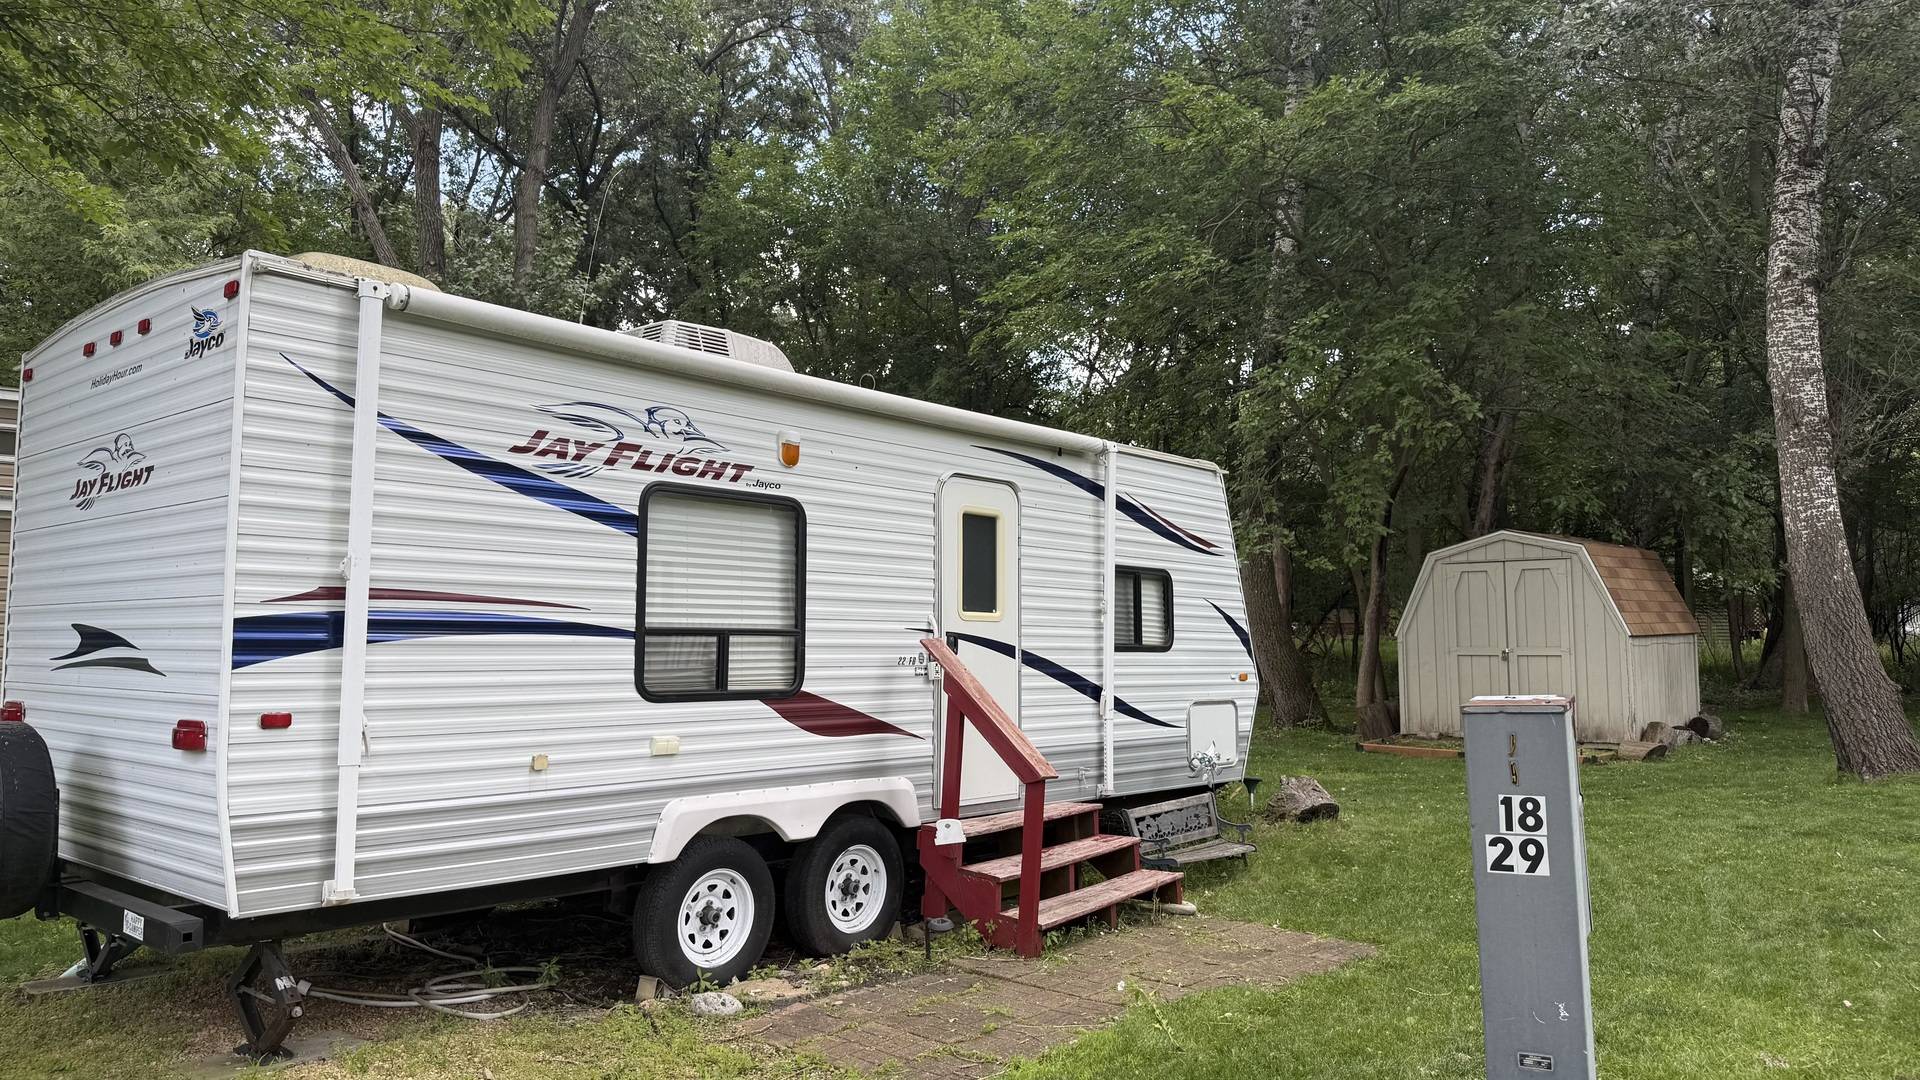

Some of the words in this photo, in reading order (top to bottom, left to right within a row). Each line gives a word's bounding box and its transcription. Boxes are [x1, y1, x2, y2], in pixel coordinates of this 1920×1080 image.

[184, 332, 225, 359] Jayco
[90, 363, 143, 389] HolidayHour.com
[508, 430, 604, 462] JAY
[602, 442, 755, 483] FLIGHT
[69, 478, 98, 500] JAY
[96, 464, 155, 495] FLIGHT
[752, 479, 781, 490] Jayco
[897, 656, 907, 666] 22
[1500, 796, 1544, 833] 18
[1488, 836, 1545, 874] 29
